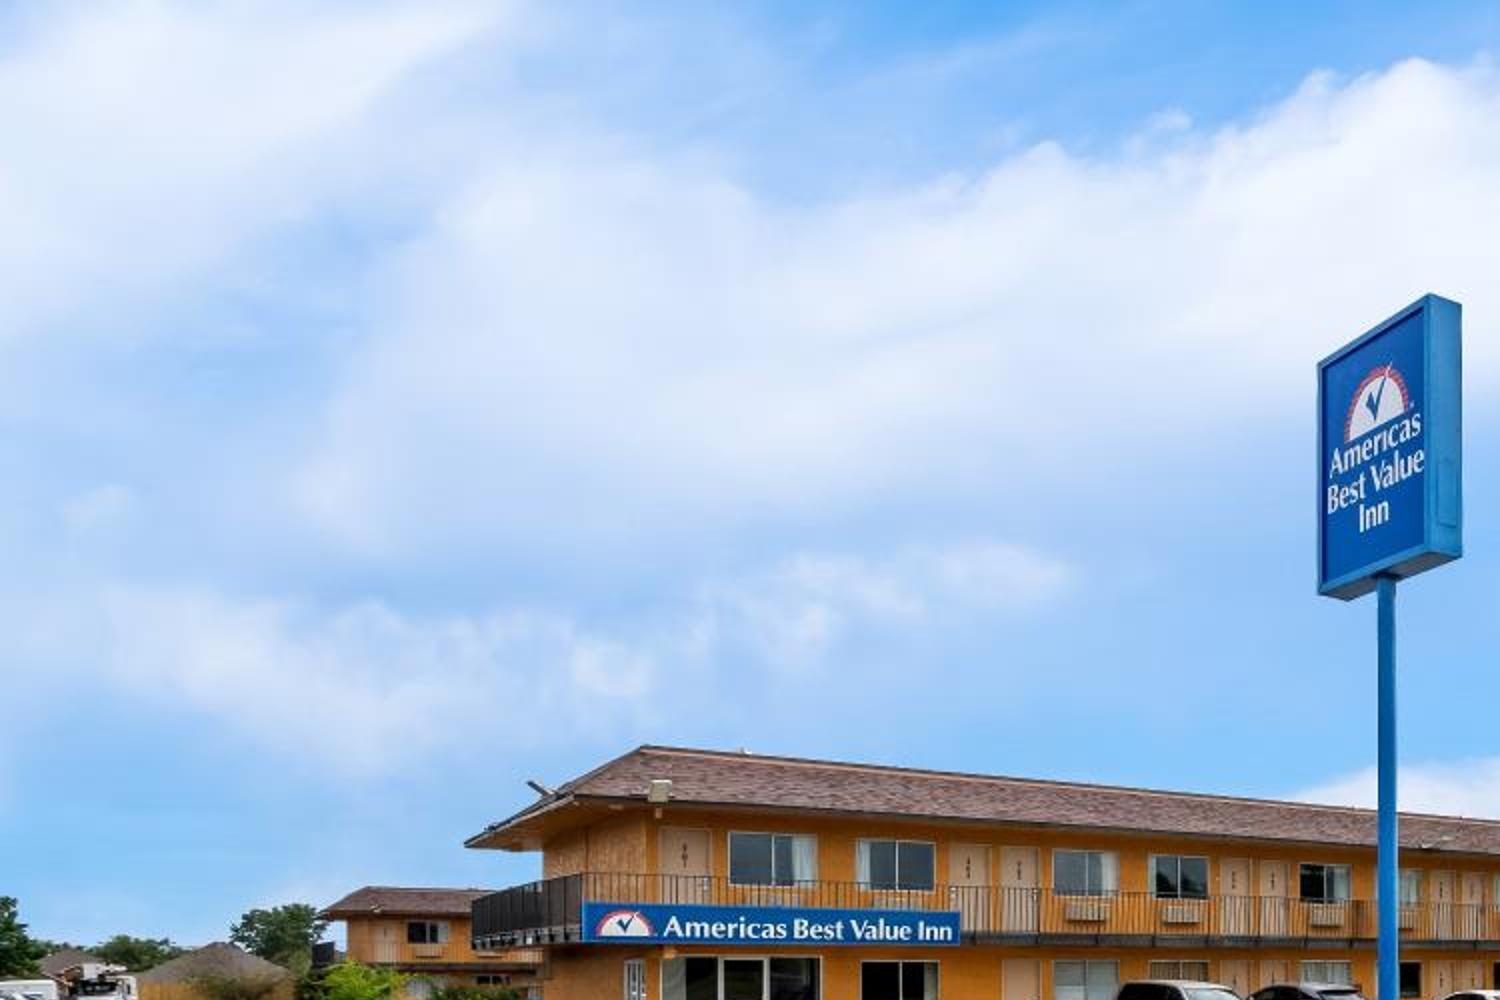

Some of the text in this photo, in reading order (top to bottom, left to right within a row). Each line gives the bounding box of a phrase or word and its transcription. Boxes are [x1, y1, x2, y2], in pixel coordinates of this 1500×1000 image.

[1329, 412, 1421, 479] Americas
[1326, 448, 1425, 515] Best Value
[1359, 500, 1389, 533] Inn
[663, 915, 953, 942] Americas Best Value Inn
